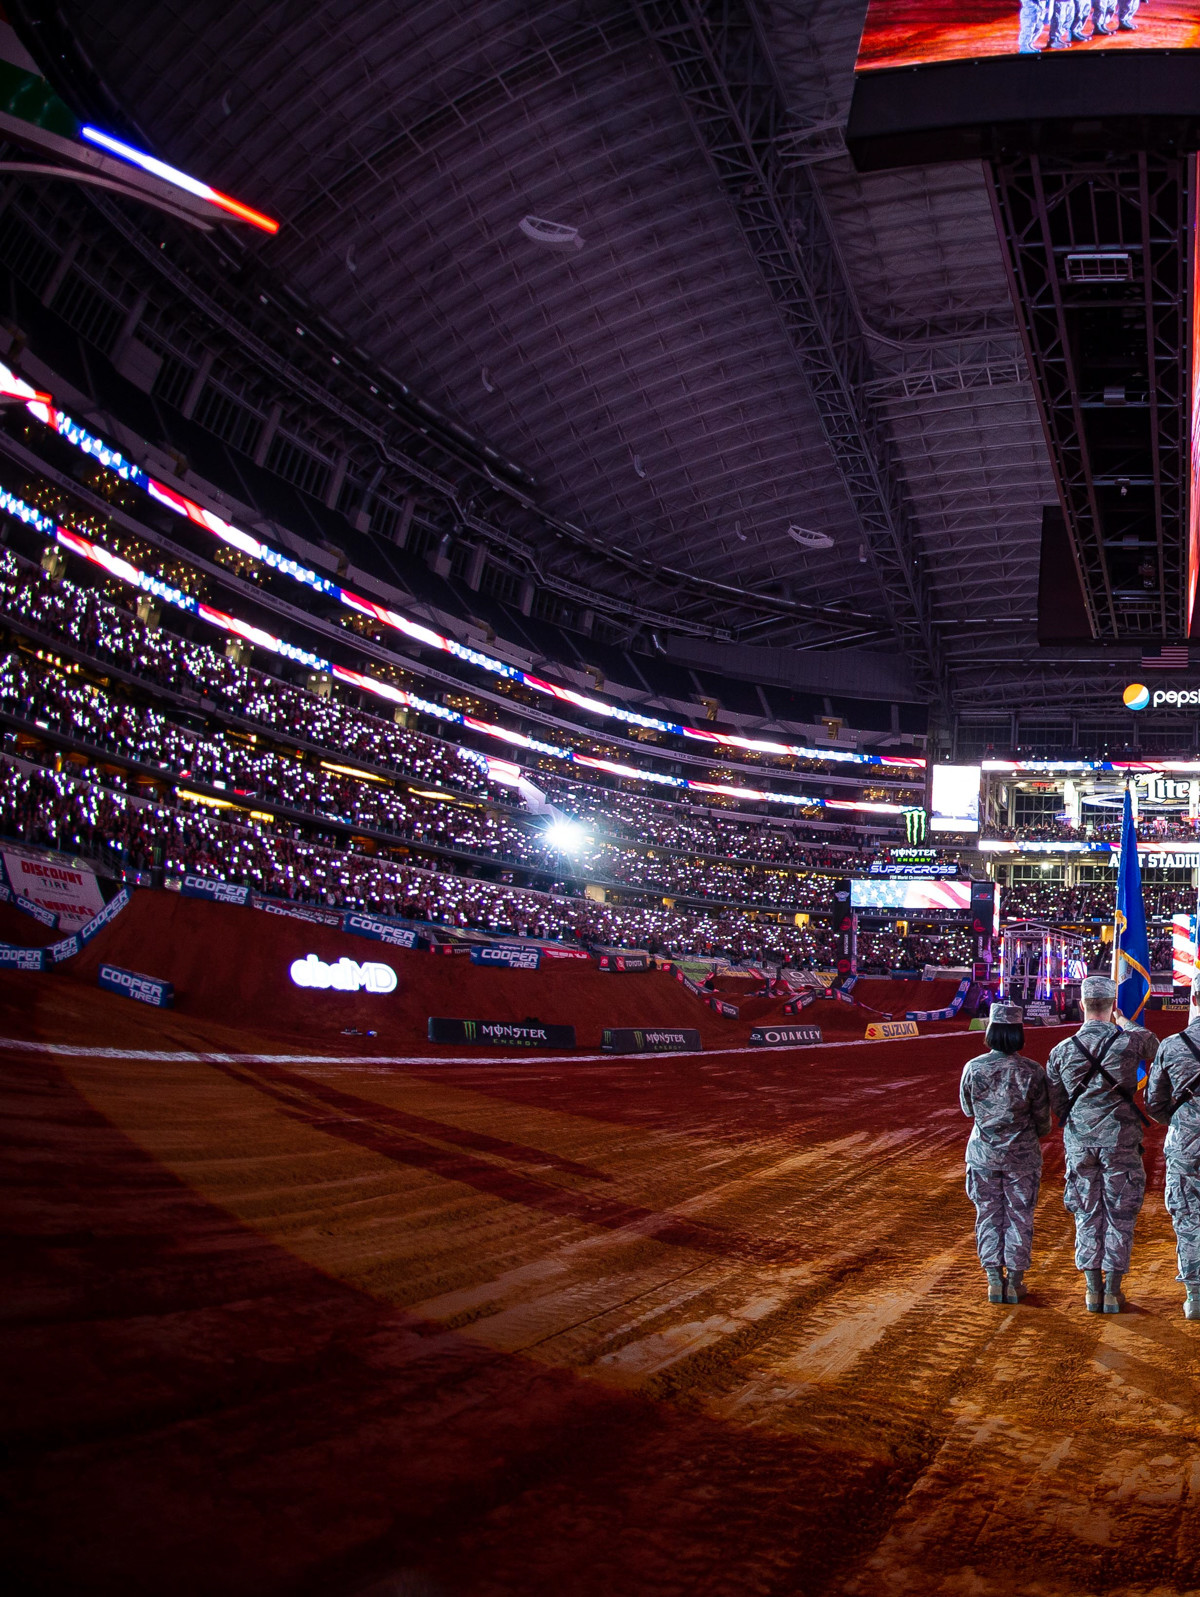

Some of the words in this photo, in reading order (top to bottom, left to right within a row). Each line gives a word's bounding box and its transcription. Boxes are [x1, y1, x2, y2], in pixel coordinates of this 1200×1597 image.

[1143, 777, 1192, 804] Lite
[890, 848, 937, 857] MONSTER
[1148, 852, 1200, 868] STADIU
[21, 861, 83, 886] DISCOUNT
[870, 865, 957, 874] SUPERCROSS
[41, 878, 69, 890] TIRE
[184, 876, 249, 897] COOPER
[215, 892, 246, 905] TIRES
[17, 897, 55, 921] COOPER
[82, 888, 129, 938] COOPER
[350, 916, 416, 941] COOPER
[381, 933, 414, 948] TIRES
[481, 949, 539, 963] COOPER
[17, 960, 41, 970] TIRES
[509, 960, 537, 969] TIRES
[101, 966, 163, 997] COOPER
[129, 988, 162, 1006] TIRES
[482, 1024, 547, 1040] MONSTER
[882, 1023, 915, 1037] SUZUKI
[493, 1038, 538, 1046] ENERGY
[646, 1032, 686, 1044] MONSTER
